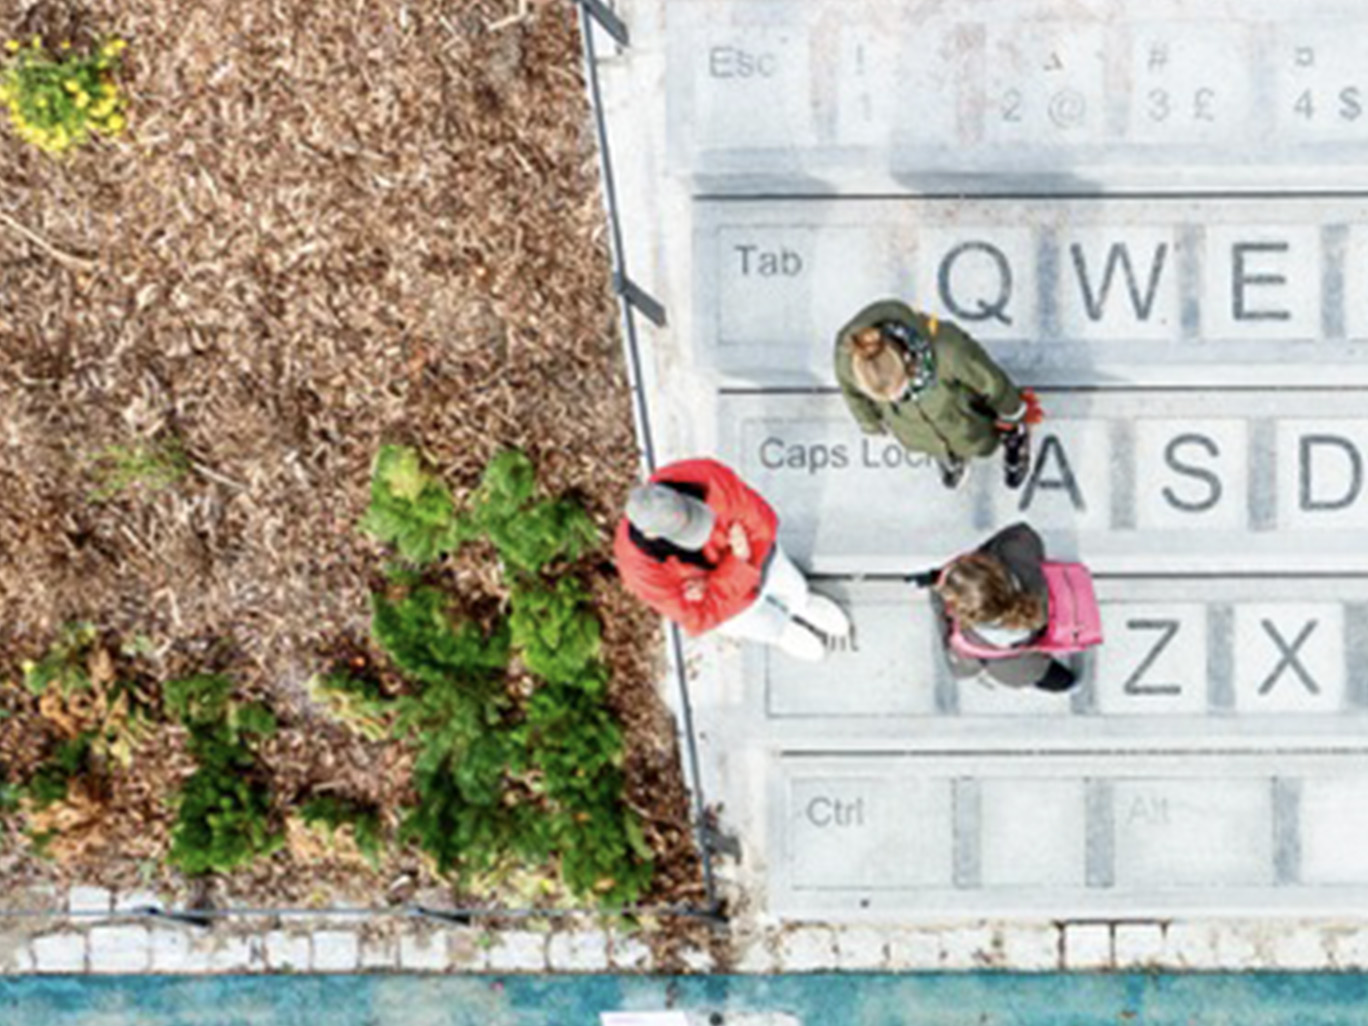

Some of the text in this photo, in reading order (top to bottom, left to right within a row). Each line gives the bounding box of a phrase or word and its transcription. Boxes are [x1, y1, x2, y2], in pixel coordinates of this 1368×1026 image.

[709, 46, 776, 79] Esc
[1000, 90, 1087, 130] 2 @
[1147, 89, 1217, 122] 3 £
[1294, 87, 1363, 122] 4 $
[735, 245, 803, 277] Tab
[937, 240, 1013, 325] Q
[1070, 242, 1168, 321] W
[1231, 242, 1291, 321] E
[759, 438, 848, 475] Caps
[1018, 433, 1086, 513] A
[1162, 433, 1223, 513] S
[1299, 434, 1363, 511] D
[1124, 619, 1182, 694] Z
[1258, 618, 1320, 695] X
[807, 796, 863, 828] Ctrl
[1127, 796, 1170, 825] Alt
